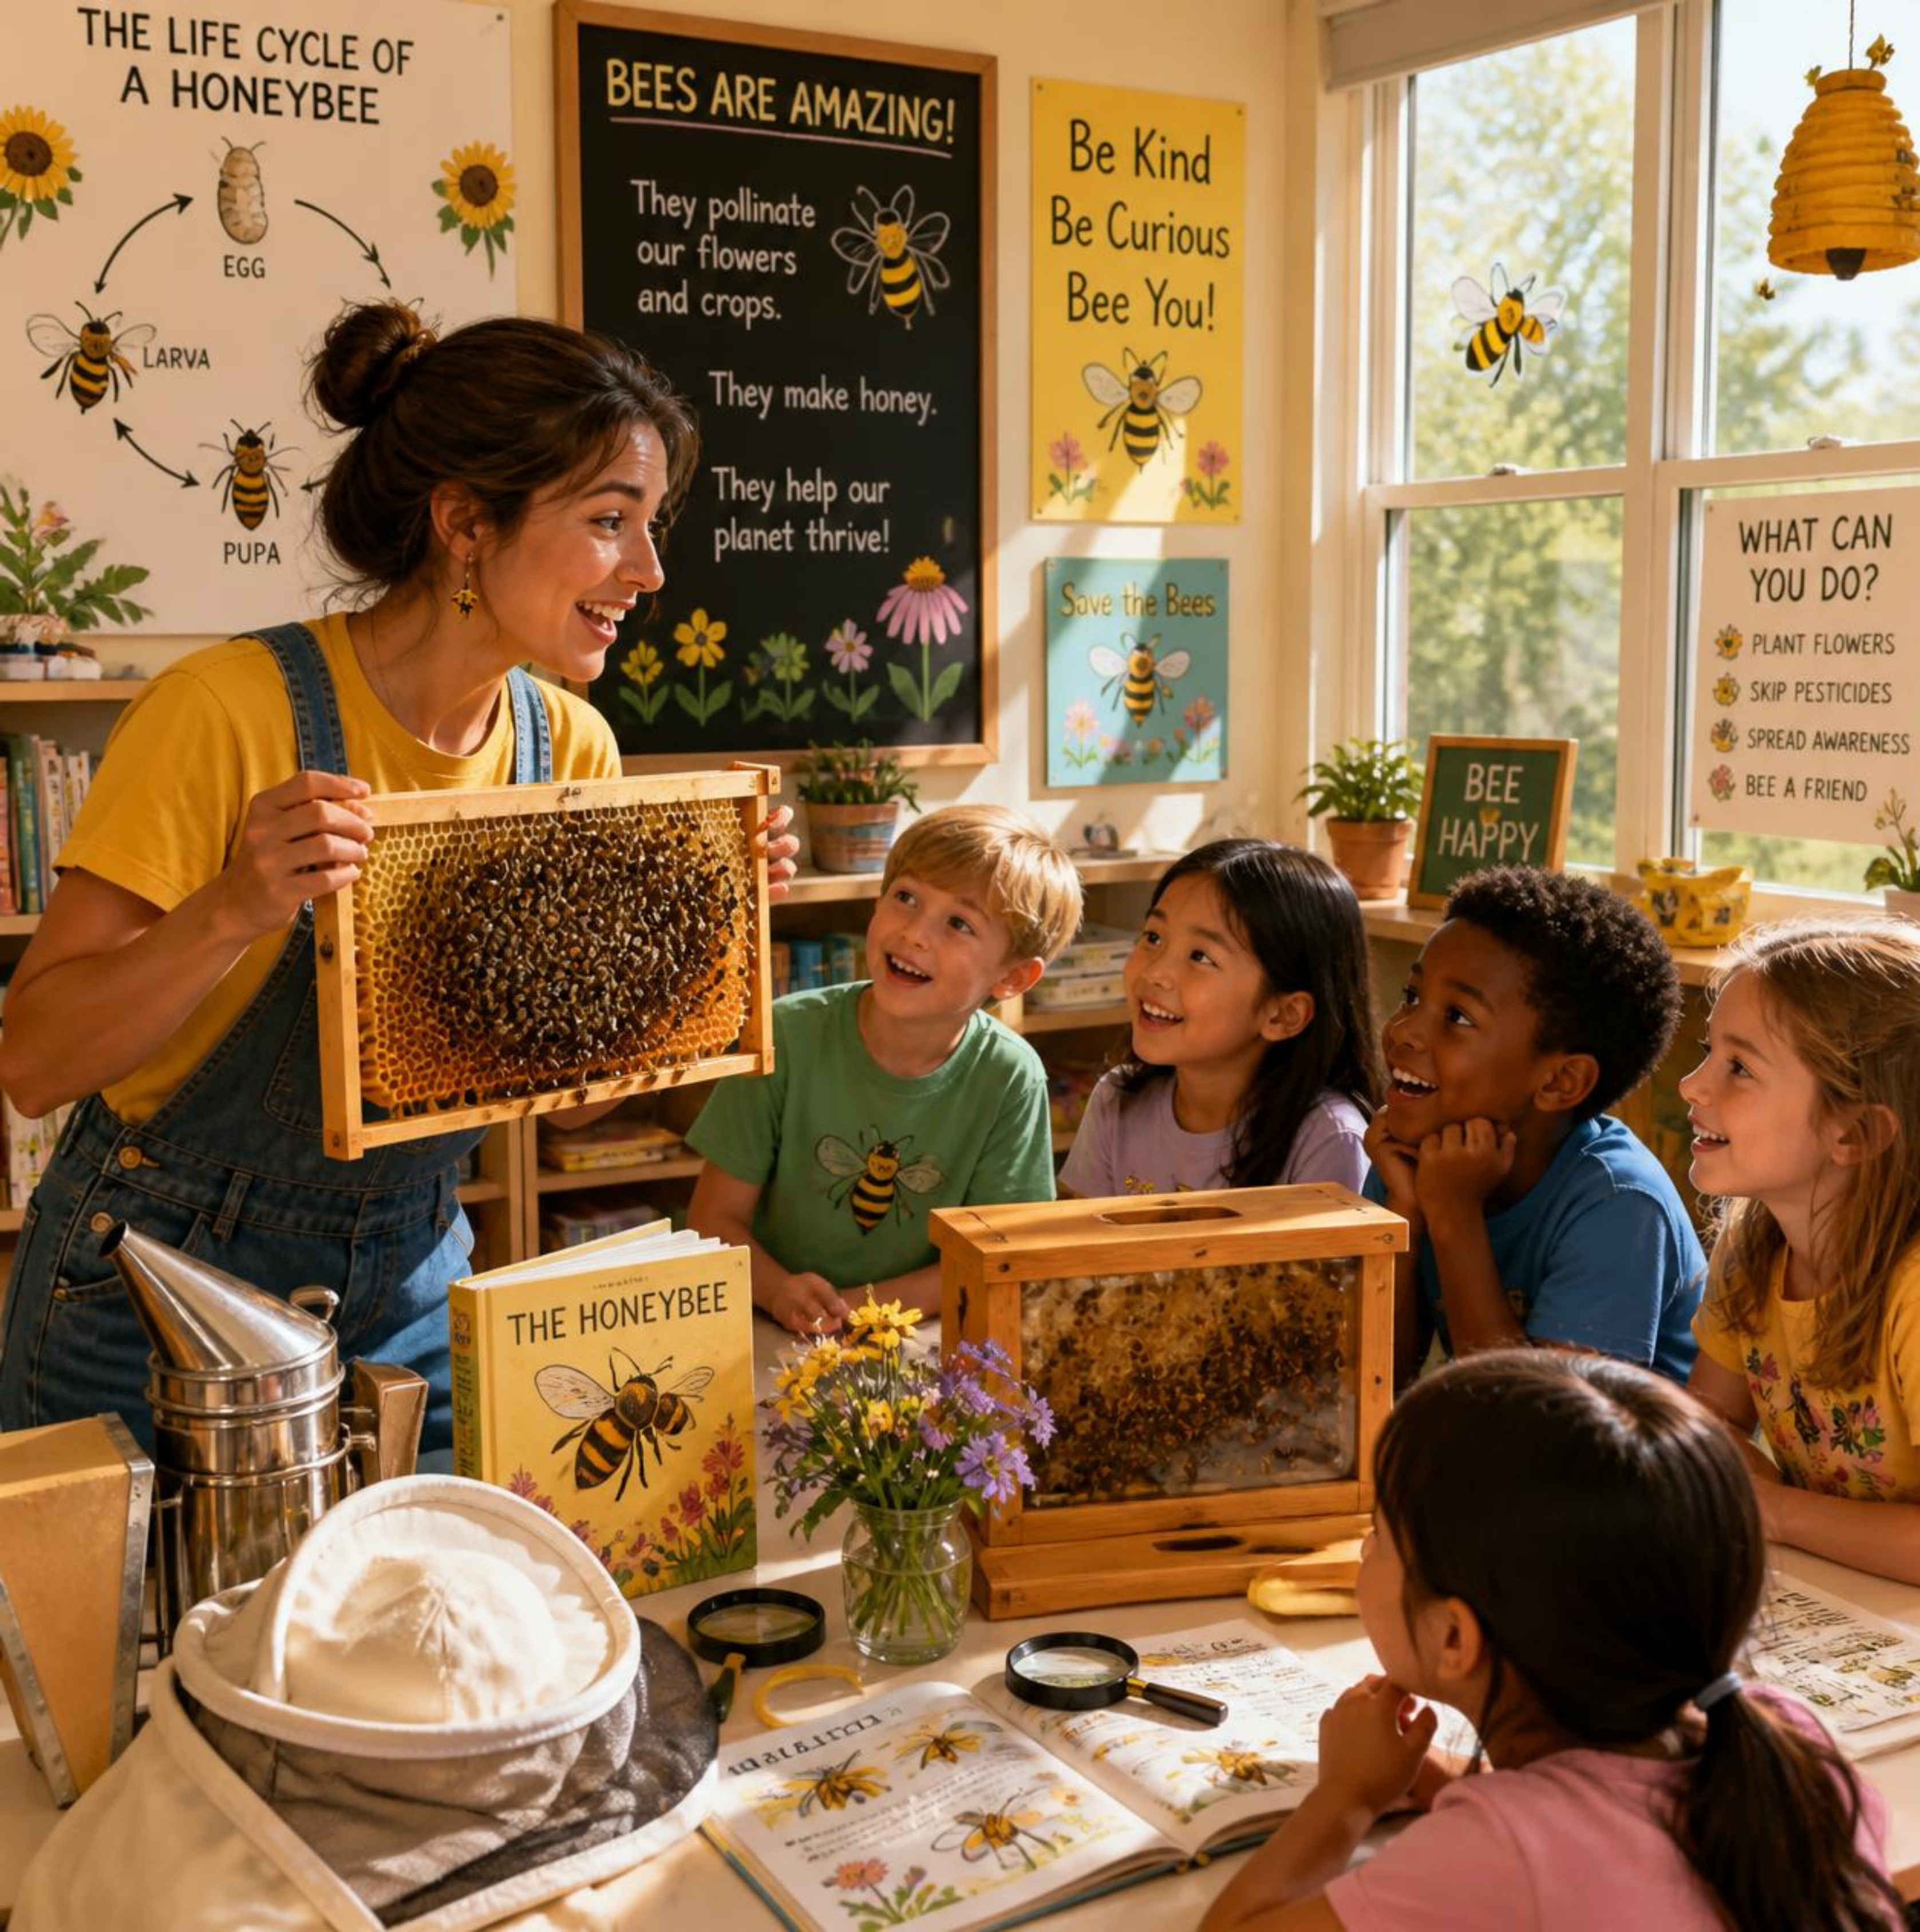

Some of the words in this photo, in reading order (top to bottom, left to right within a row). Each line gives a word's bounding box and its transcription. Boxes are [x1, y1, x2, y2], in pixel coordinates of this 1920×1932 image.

[77, 7, 151, 52] THE
[168, 16, 240, 60] LIFE
[256, 26, 359, 71] CYCLE
[372, 38, 414, 76] OF
[120, 65, 149, 105] A
[172, 69, 380, 125] HONEYBEE
[607, 58, 697, 113] BEES
[710, 72, 776, 121] ARE
[790, 81, 954, 144] AMAZING!
[1070, 118, 1115, 175] Be
[1135, 127, 1210, 185] Kind
[630, 179, 697, 230] They
[709, 187, 816, 232] pollinate
[1051, 195, 1093, 247] Be
[1107, 200, 1230, 259] Curious
[224, 254, 265, 279] EGG
[637, 240, 685, 266] our
[697, 234, 797, 275] flowers
[638, 279, 689, 314] and
[701, 293, 781, 331] crops.
[1068, 271, 1129, 325] Bee
[1144, 277, 1214, 331] You!
[143, 346, 210, 369] LARVA
[708, 370, 773, 420] They
[784, 374, 849, 410] make
[860, 376, 937, 426] honey.
[710, 466, 775, 513] They
[787, 467, 837, 514] help
[848, 481, 890, 504] our
[224, 542, 281, 565] PUPA
[714, 516, 795, 563] planet
[805, 517, 889, 553] thrive!
[1739, 517, 1819, 554] WHAT
[1832, 513, 1893, 551] CAN
[1061, 582, 1112, 617] Save
[1121, 581, 1157, 617] the
[1166, 583, 1216, 617] Bees
[1750, 568, 1806, 603] YOU
[1821, 563, 1879, 602] DO?
[1752, 633, 1806, 655] PLANT
[1814, 633, 1895, 655] FLOWERS
[1750, 681, 1787, 702] SKIP
[1795, 681, 1892, 704] PESTICIDES
[1748, 728, 1807, 750] SPREAD
[1812, 730, 1910, 755] AWARENESS
[1464, 763, 1523, 804] BEE
[1746, 774, 1776, 797] BEE
[1783, 777, 1796, 799] A
[1804, 777, 1867, 802] FRIEND
[1438, 817, 1539, 862] HAPPY
[507, 1306, 566, 1346] THE
[579, 1281, 728, 1335] HONEYBEE
